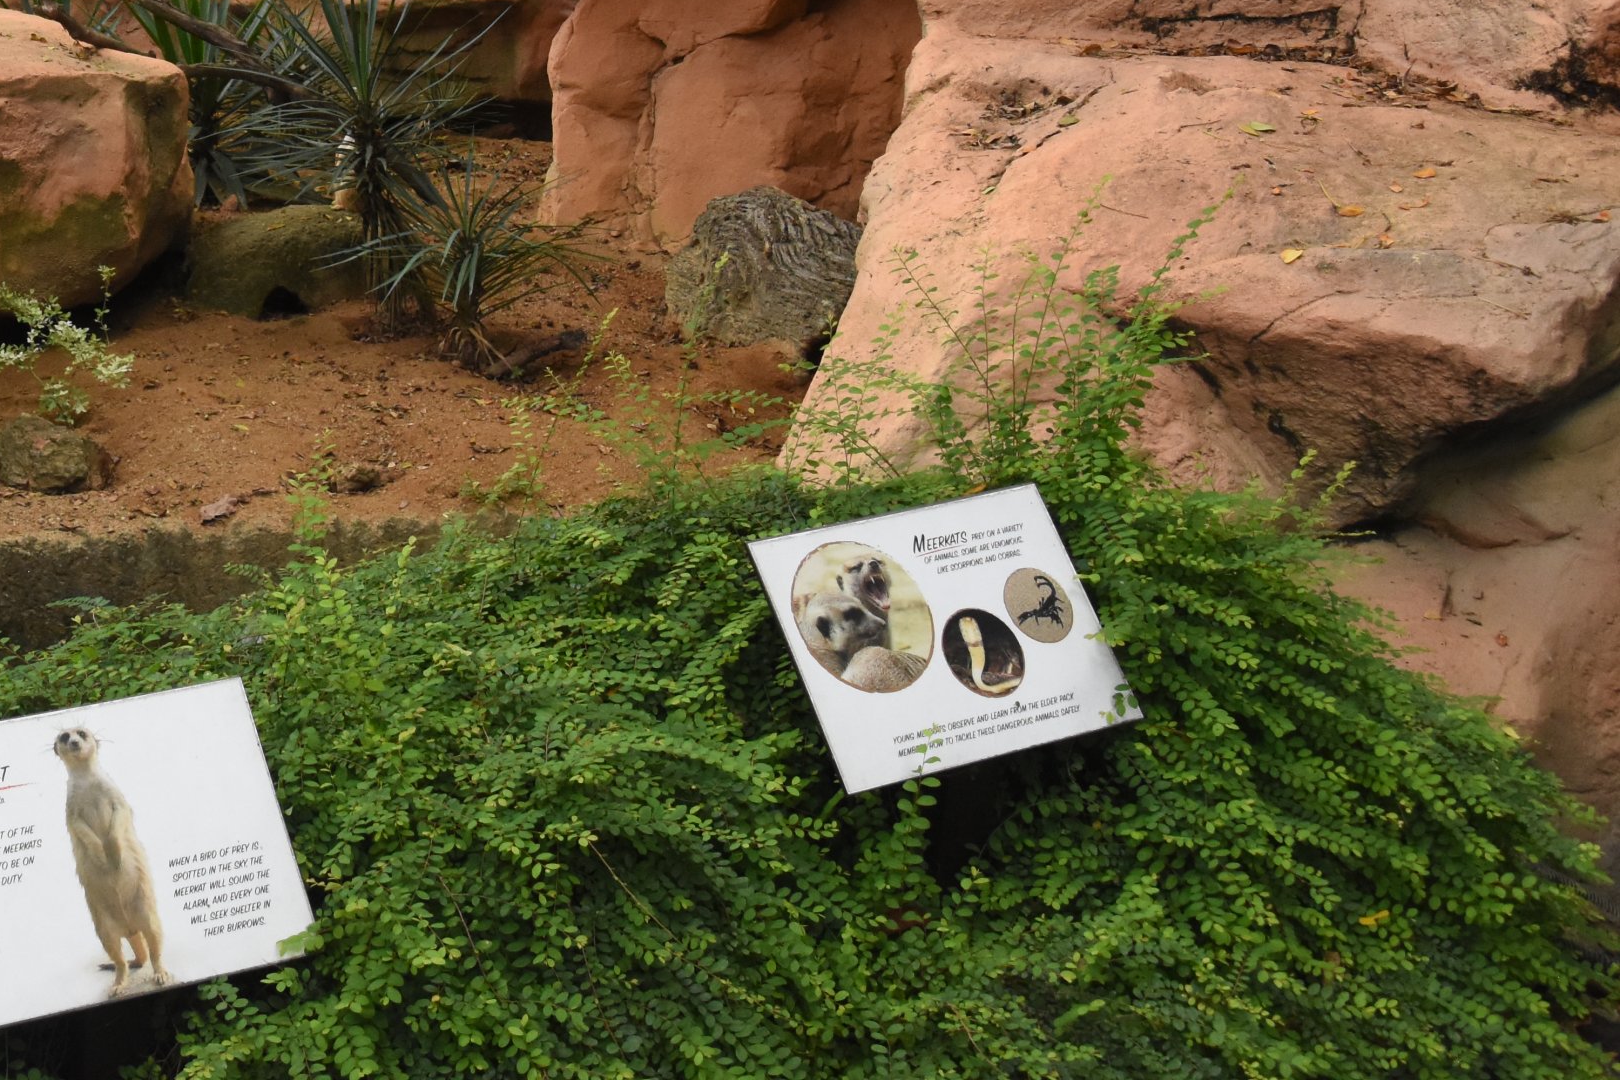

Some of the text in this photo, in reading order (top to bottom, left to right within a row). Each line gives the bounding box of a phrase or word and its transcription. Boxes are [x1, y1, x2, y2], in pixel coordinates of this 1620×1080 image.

[913, 531, 967, 554] MEERKATS
[972, 532, 984, 540] PREY
[1002, 523, 1023, 534] VARIETY
[924, 556, 932, 564] OF
[961, 546, 977, 555] SOME
[980, 543, 989, 551] ARE
[937, 565, 948, 574] LIKE
[950, 558, 983, 571] SCORPIONS
[985, 554, 996, 562] AND
[893, 733, 914, 744] YOUNG
[948, 717, 974, 731] OBSERVE
[977, 714, 988, 723] AND
[991, 709, 1008, 720] LEARN
[1010, 704, 1026, 714] FROM
[1028, 701, 1039, 709] THE
[1041, 697, 1057, 707] ELDER
[1060, 693, 1074, 702] PACK
[946, 737, 953, 745] TO
[955, 732, 976, 742] TACKLE
[977, 727, 995, 737] THESE
[997, 717, 1033, 732] DANGEROUS
[1035, 710, 1059, 721] ANIMALS
[7, 828, 18, 838] OF
[20, 825, 34, 835] THE
[3, 839, 42, 854] MEERKATS
[169, 841, 259, 868] WHEN A BIRD OF PREY IS
[11, 859, 20, 868] BE
[23, 856, 34, 866] ON
[172, 868, 206, 882] SPOTTED
[209, 865, 216, 875] IN
[218, 862, 232, 872] THE
[250, 855, 263, 865] THE
[174, 869, 270, 897] MEERKAT WILL SOUND THE
[213, 894, 227, 904] AND
[230, 889, 252, 901] EVERY
[255, 884, 269, 895] ONE
[191, 899, 271, 924] WILL SEEK SHELTER IN
[204, 925, 224, 938] THEIR
